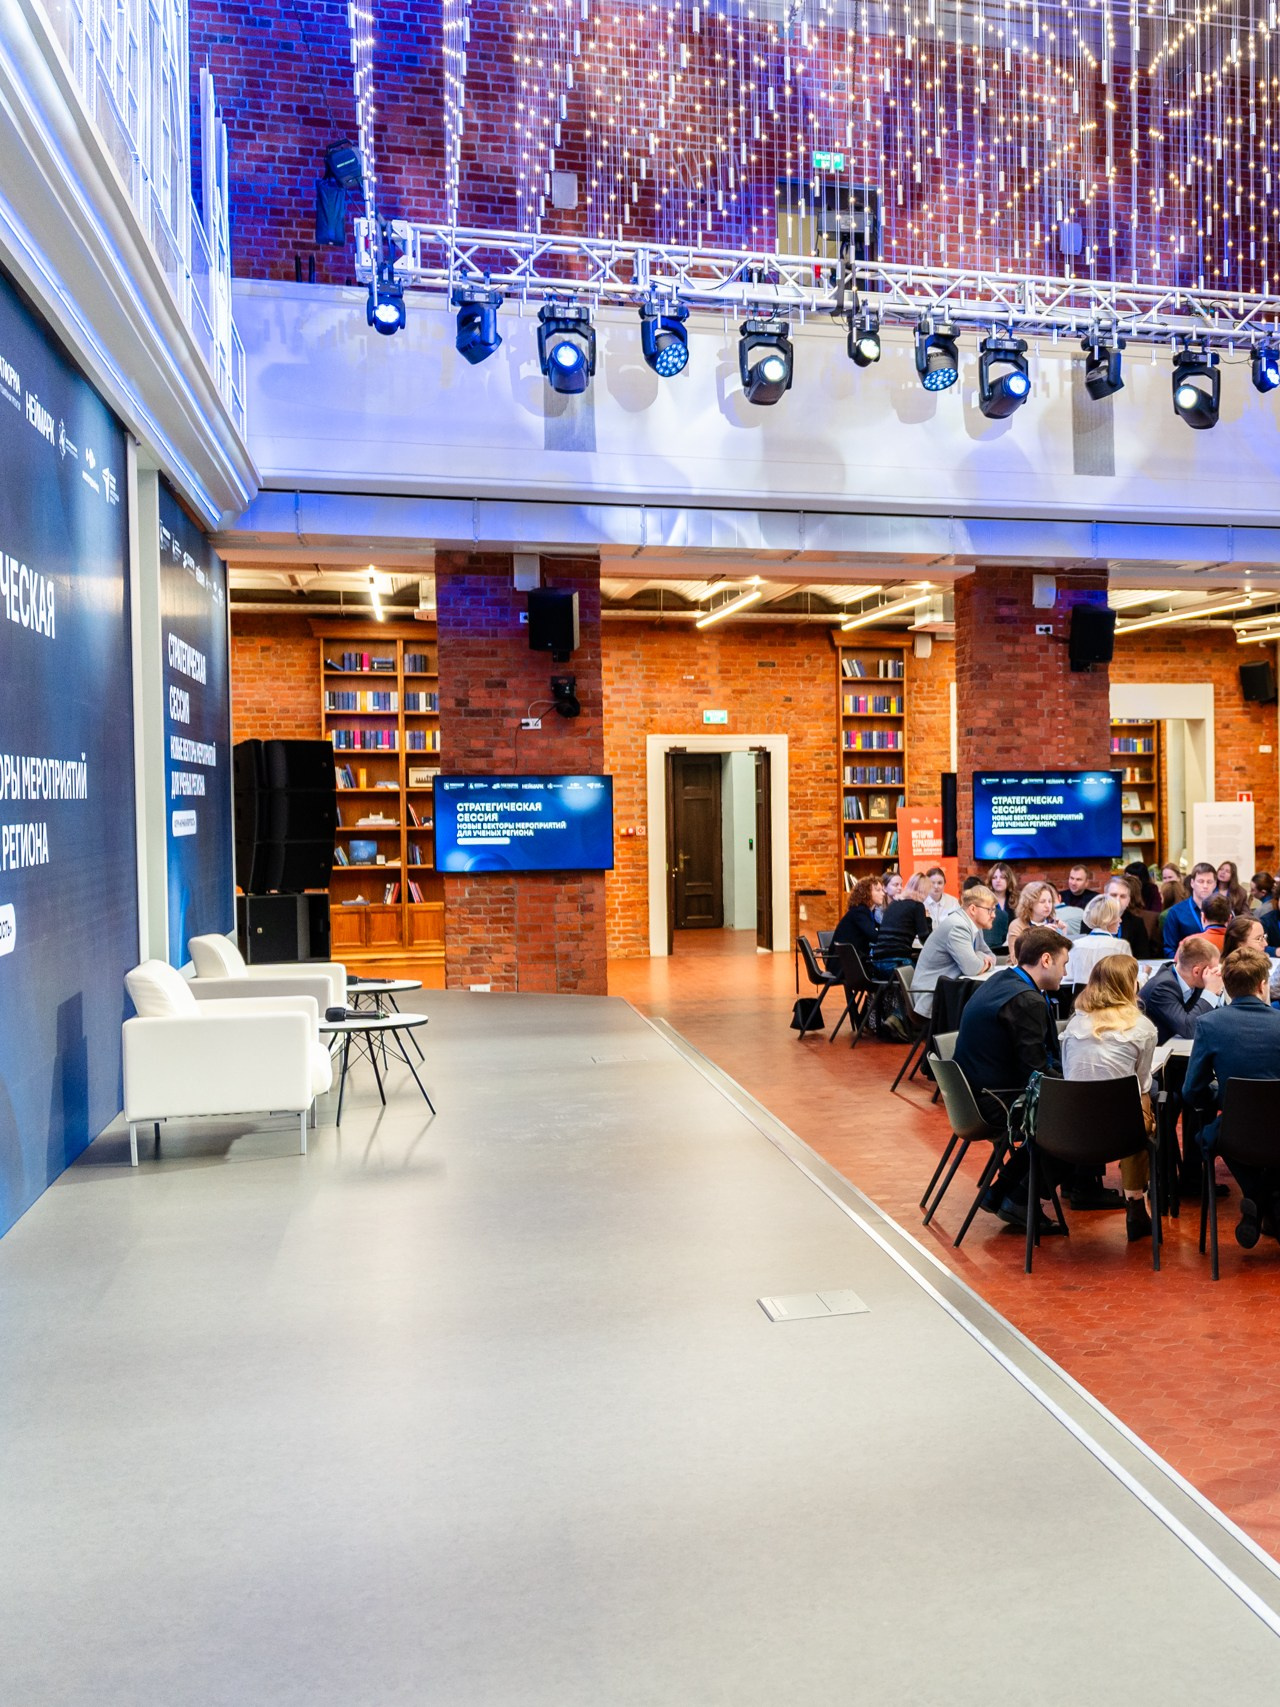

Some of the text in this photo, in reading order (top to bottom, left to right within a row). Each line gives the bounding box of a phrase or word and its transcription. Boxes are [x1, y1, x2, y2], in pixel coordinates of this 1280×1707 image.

[25, 390, 55, 446] НЕЙМАРК
[0, 551, 55, 639] ЧЕСКАЯ
[168, 632, 207, 686] СТРАТЕГИЧЕСКАЯ
[169, 685, 190, 724] СЕССИЯ
[22, 752, 88, 800] МЕРОПРИЯТИЙ
[991, 796, 1063, 805] СТРАТЕГИЧЕСКАЯ
[456, 802, 542, 812] СТРАТЕГИЧЕСКАЯ
[992, 805, 1027, 814] СЕССИЯ
[456, 812, 498, 822] СЕССИЯ
[1040, 812, 1084, 821] МЕРОПРИЯТИЙ
[515, 820, 566, 829] МЕРОПРИЯТИЙ
[472, 829, 502, 837] УЧЕНЫХ
[2, 822, 49, 871] РЕГИОНА
